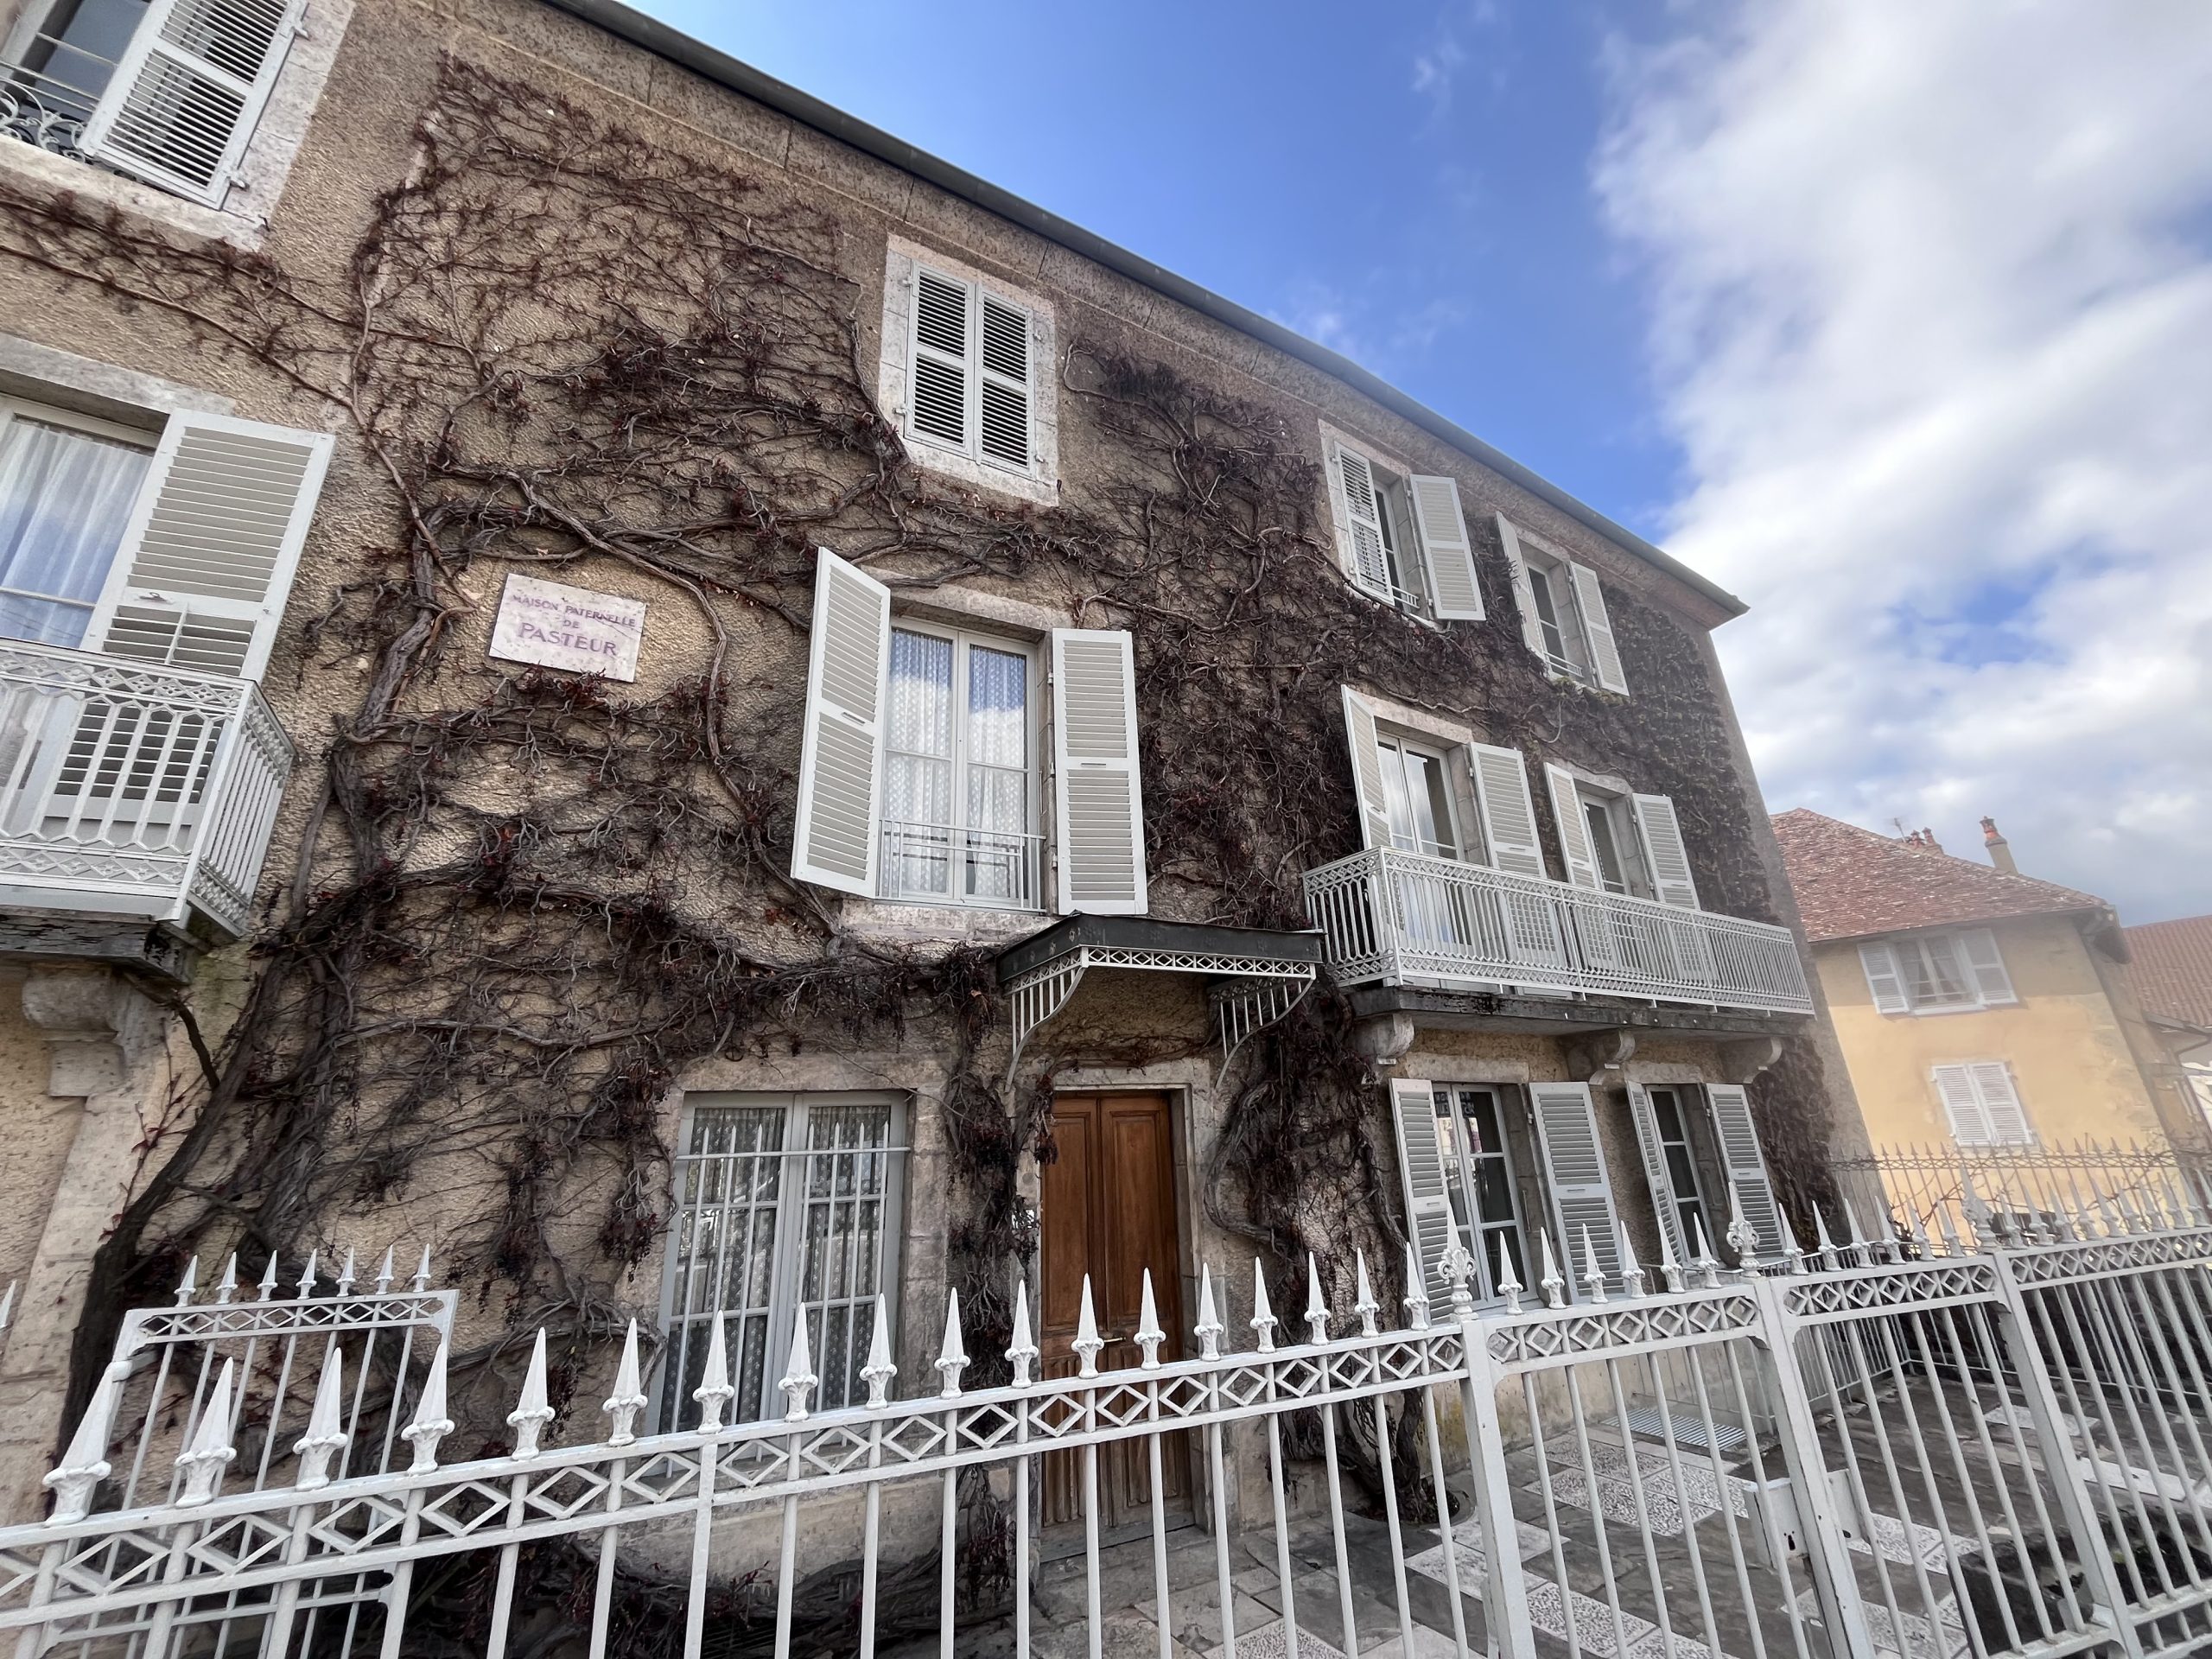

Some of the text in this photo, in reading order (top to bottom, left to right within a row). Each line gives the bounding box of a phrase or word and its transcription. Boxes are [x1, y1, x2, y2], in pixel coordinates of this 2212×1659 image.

[512, 595, 635, 627] MAISON PATERNELLE
[563, 620, 579, 629] DE
[518, 622, 617, 656] PASTEUR
